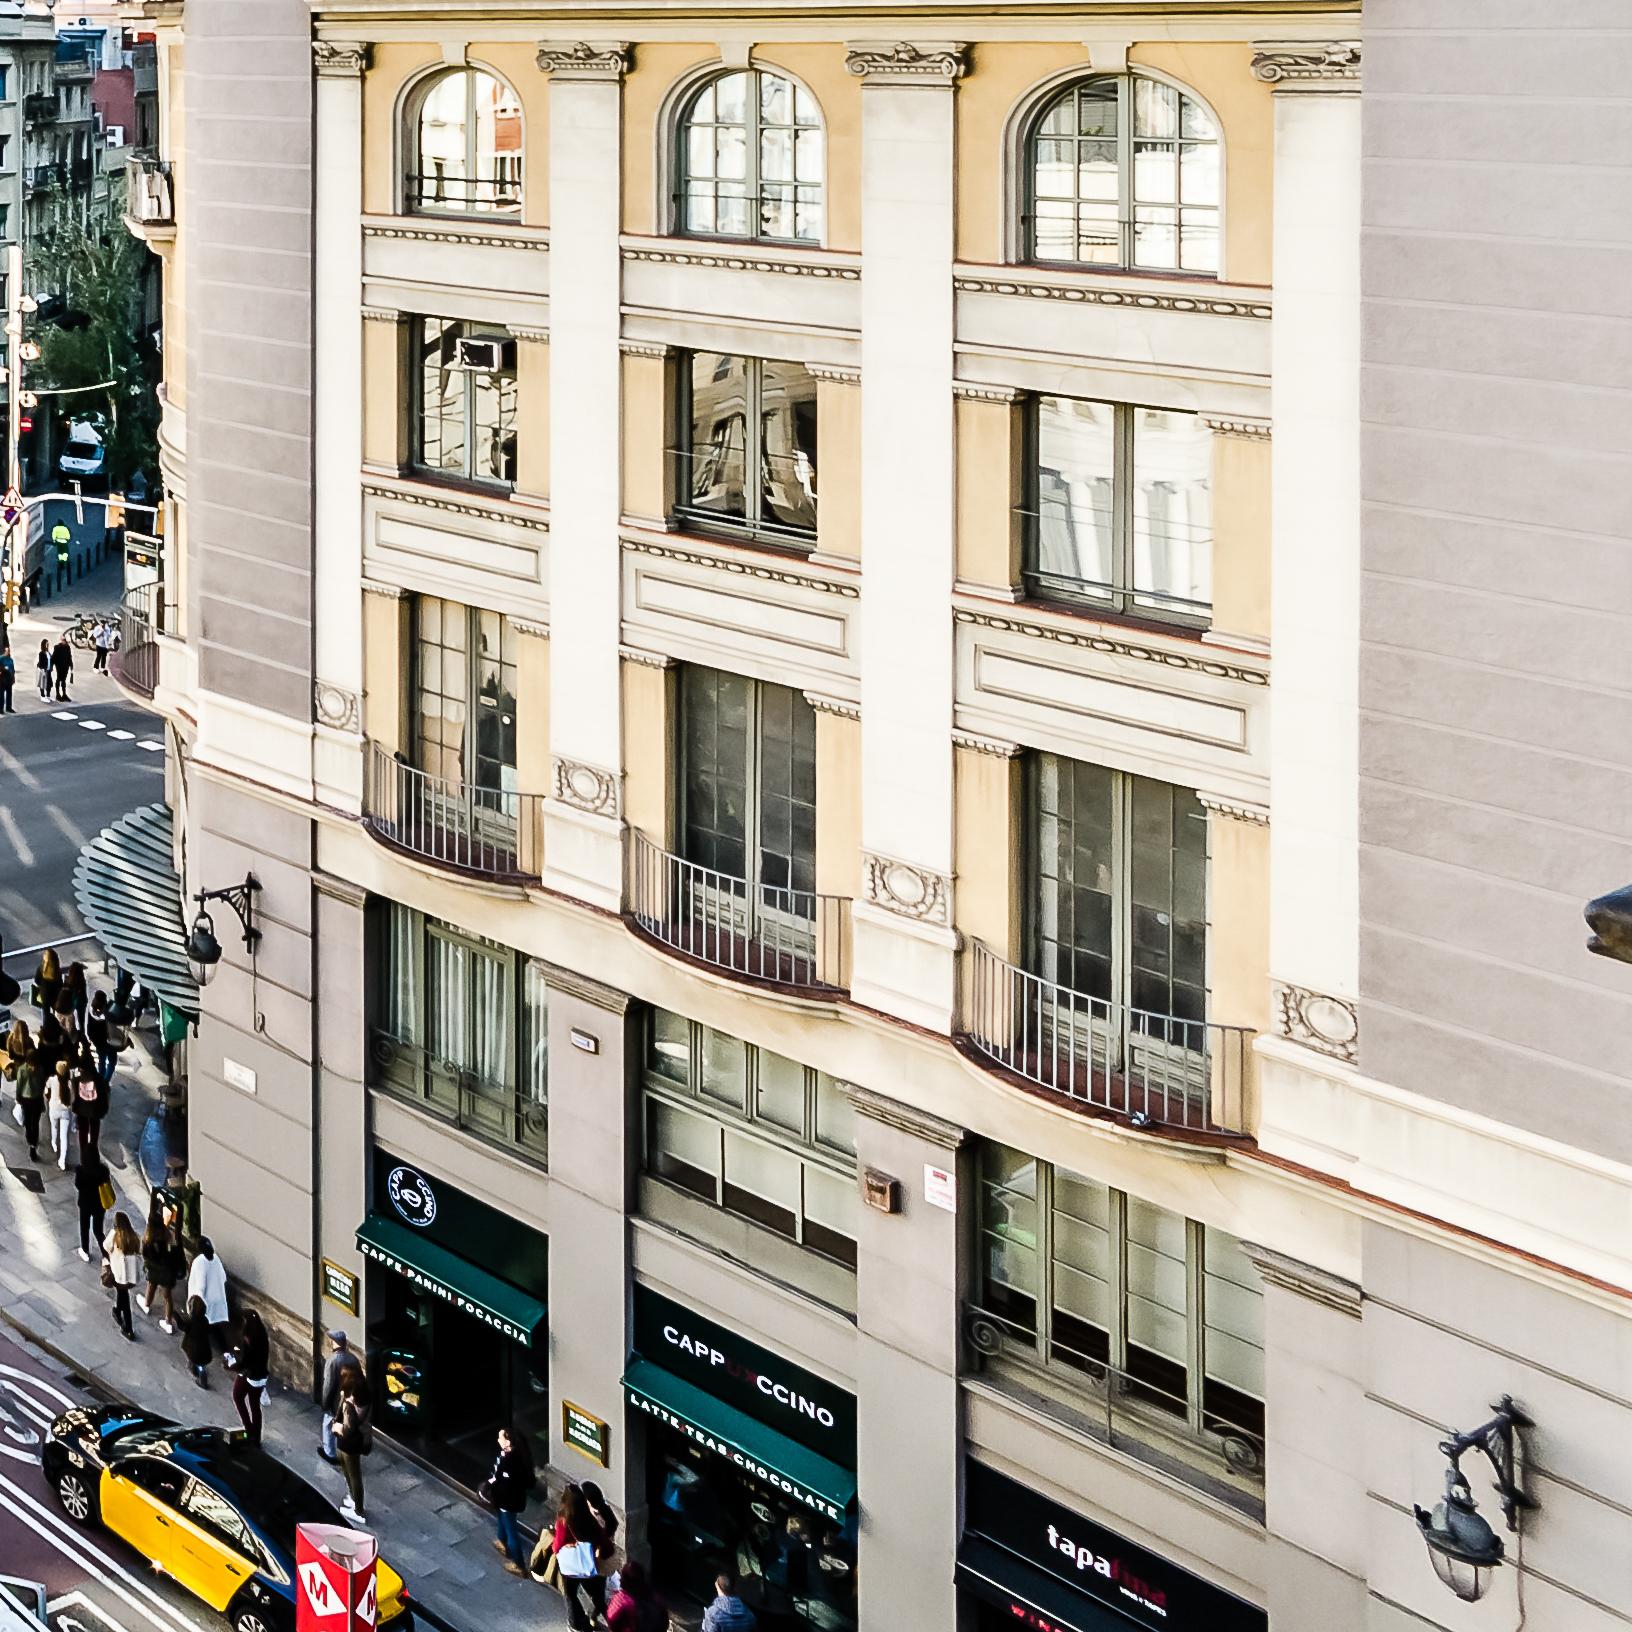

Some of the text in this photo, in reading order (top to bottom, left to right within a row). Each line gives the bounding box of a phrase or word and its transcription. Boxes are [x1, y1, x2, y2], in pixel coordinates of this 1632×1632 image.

[630, 1393, 680, 1429] LATTE
[685, 1424, 727, 1455] TEAS
[733, 1453, 839, 1520] CHOCOLATE
